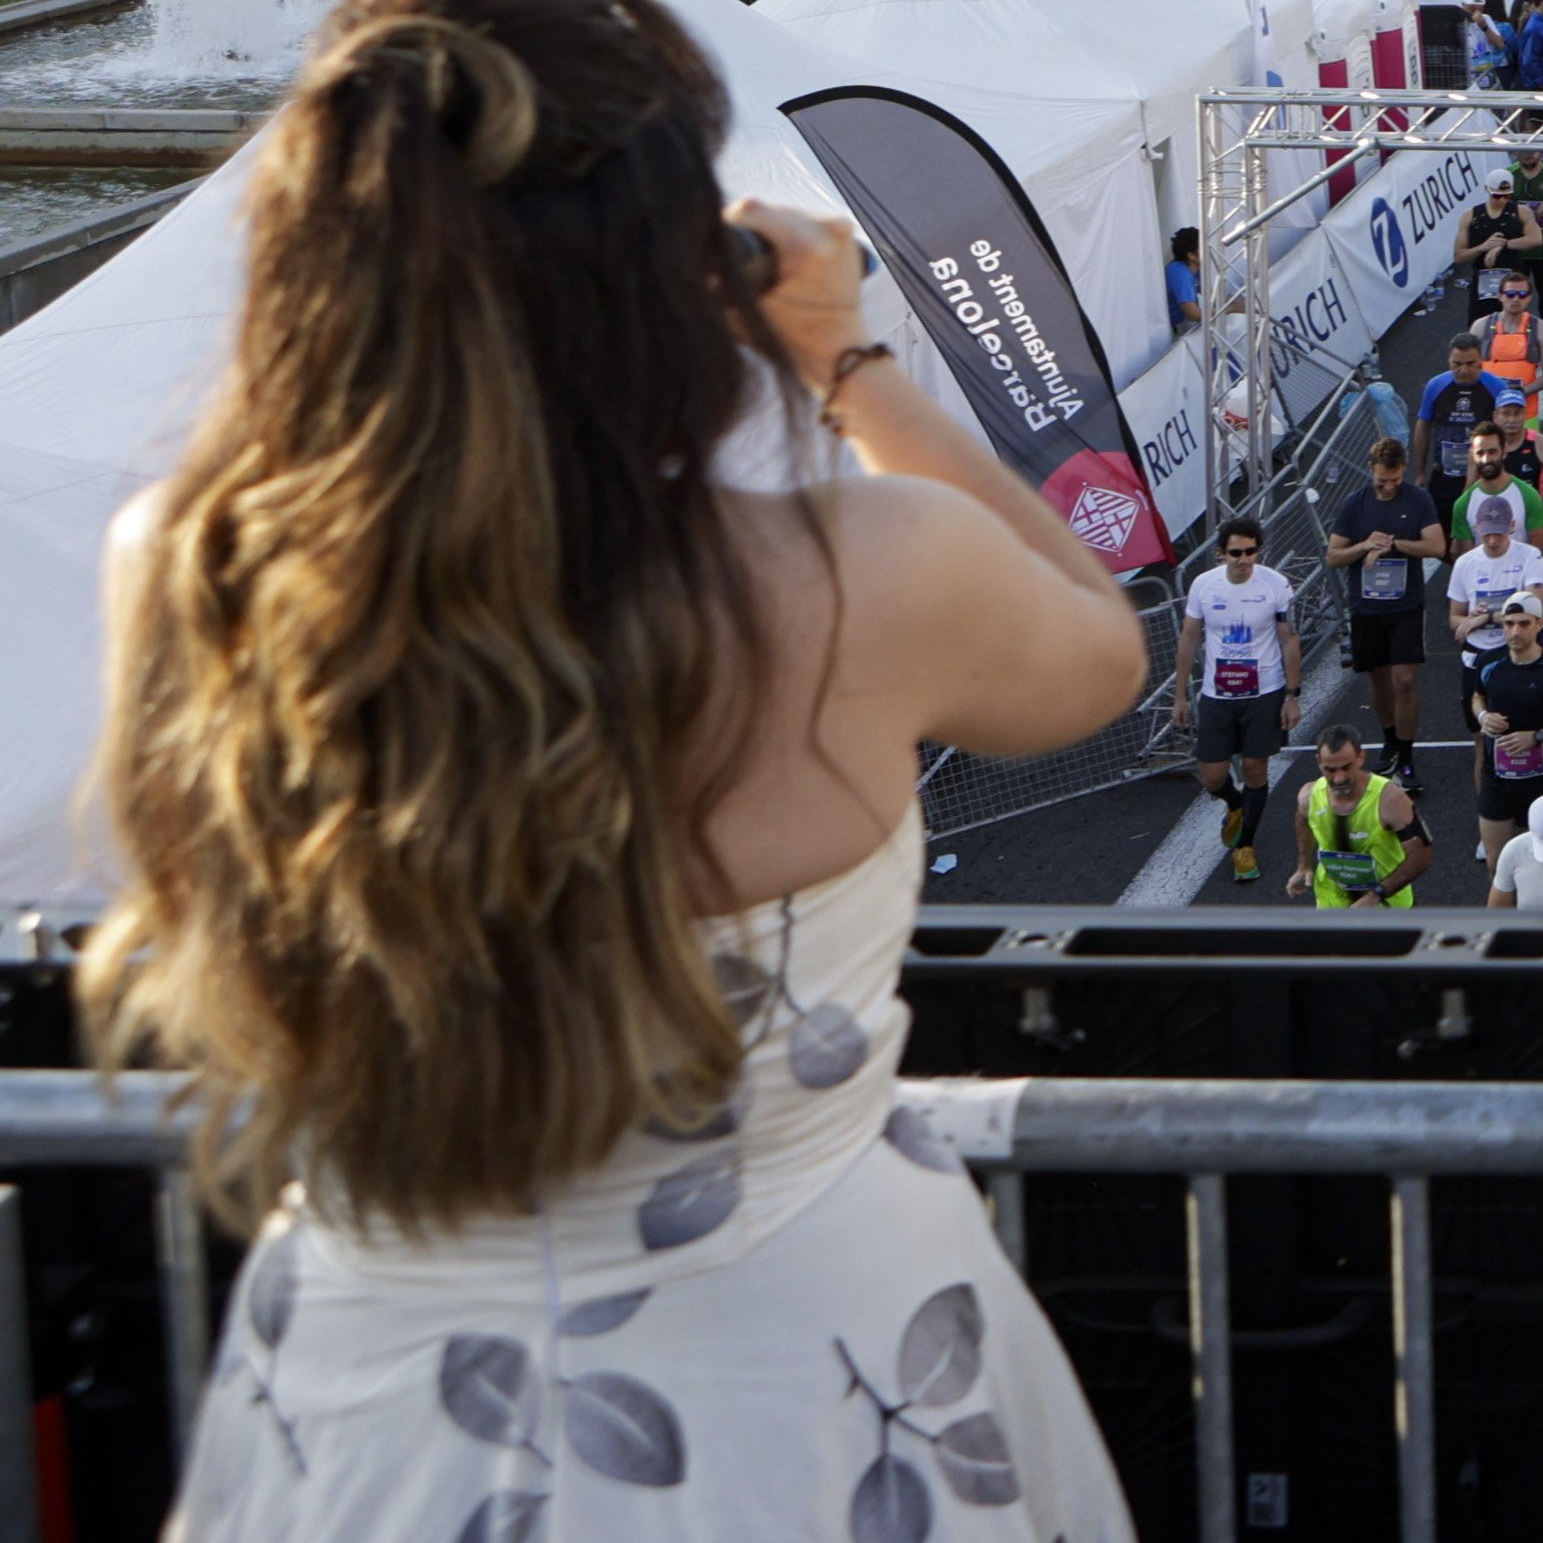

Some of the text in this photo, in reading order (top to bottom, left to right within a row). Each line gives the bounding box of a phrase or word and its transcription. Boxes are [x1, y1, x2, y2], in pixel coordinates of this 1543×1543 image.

[1402, 148, 1479, 246] ZURICH
[1268, 277, 1348, 379] URICH
[1142, 409, 1199, 487] RICH
